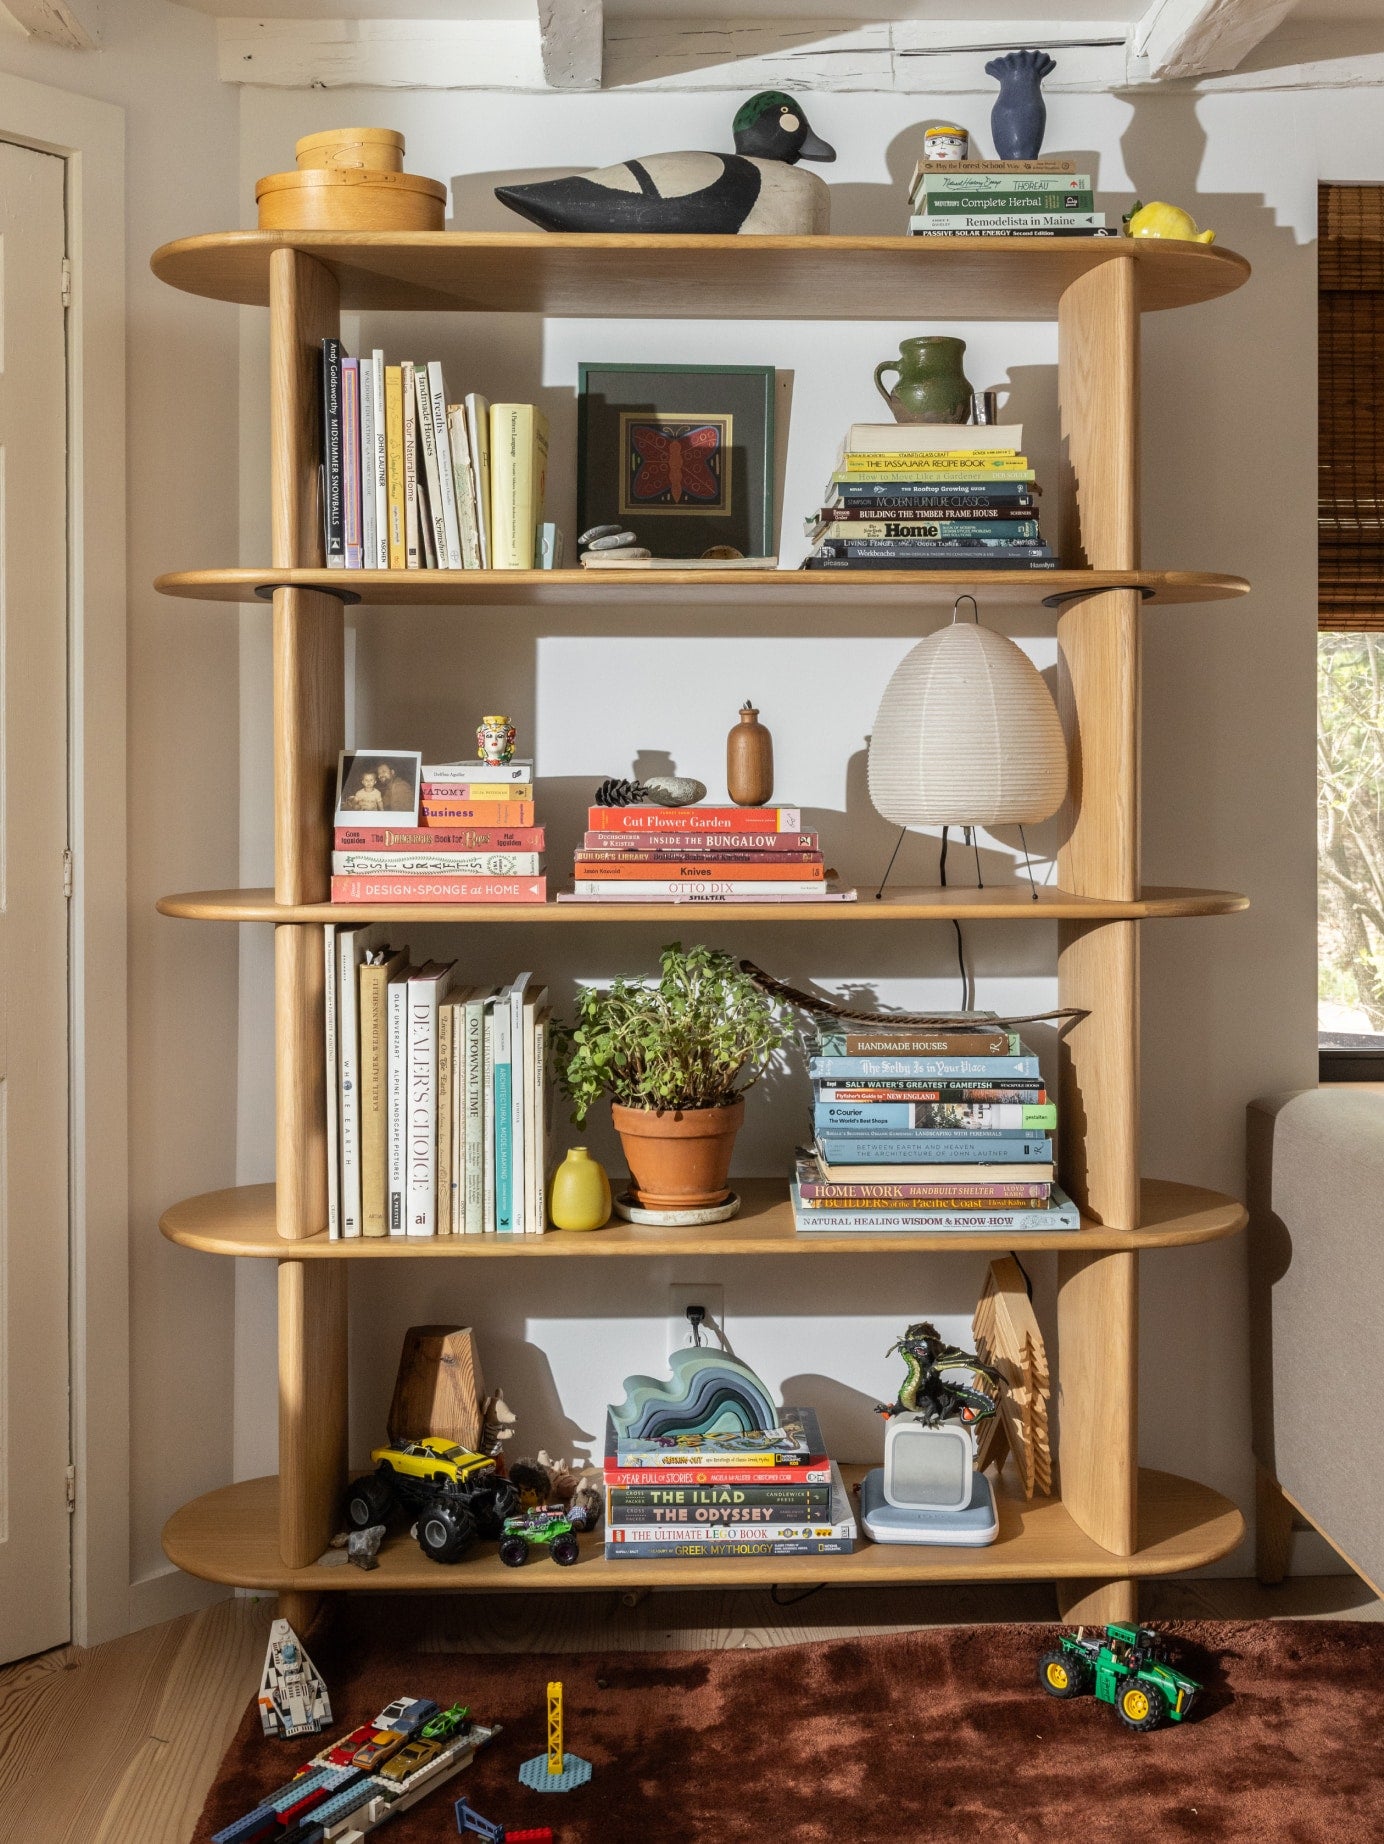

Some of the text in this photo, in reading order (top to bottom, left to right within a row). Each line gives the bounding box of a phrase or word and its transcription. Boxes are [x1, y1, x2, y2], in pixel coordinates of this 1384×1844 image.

[1012, 180, 1049, 190] THOREAU
[961, 198, 1006, 209] Complete
[1009, 198, 1042, 207] Herbal
[966, 217, 1076, 226] Remodelista in Maine
[330, 342, 338, 364] Andy
[330, 366, 338, 414] Goldsworthy
[434, 392, 444, 434] Wreaths
[406, 418, 414, 437] Your
[877, 496, 990, 506] MODERN FURNITURE CLASSICS
[860, 510, 998, 518] BUILDING THE TIMBER FRAME HOUSE
[884, 523, 938, 538] Home
[422, 808, 474, 817] Business
[623, 816, 731, 827] Cut Flower Garden
[650, 836, 681, 845] INSIDE
[706, 835, 777, 847] BUNGALOW
[680, 867, 711, 876] Knives
[366, 886, 411, 895] DESIGN
[418, 886, 466, 895] SPONGE
[470, 886, 483, 895] at
[485, 886, 519, 895] HOME
[669, 883, 734, 893] OTTO DIX
[470, 1018, 478, 1035] ON
[858, 1042, 947, 1050] HANDMADE HOUSES
[860, 1060, 986, 1076] The Selby Is in Your Place
[413, 1004, 430, 1190] DEALER'S CHOICE
[470, 1090, 478, 1117] TIME
[815, 1186, 903, 1196] HOME WORK
[825, 1199, 888, 1207] BUILDERS
[913, 1199, 949, 1208] Pacific
[951, 1199, 982, 1207] Coast
[415, 1213, 426, 1224] ai
[622, 1474, 639, 1483] YEAR
[641, 1474, 658, 1483] FULL
[666, 1474, 693, 1483] STORIES
[651, 1492, 745, 1503] THE ILIAD
[653, 1508, 773, 1521] THE ODYSSEY
[632, 1530, 768, 1540] THE ULTIMATE LEGO BOOK
[675, 1546, 707, 1554] GREEK
[710, 1544, 773, 1554] MYTHOLOGY
